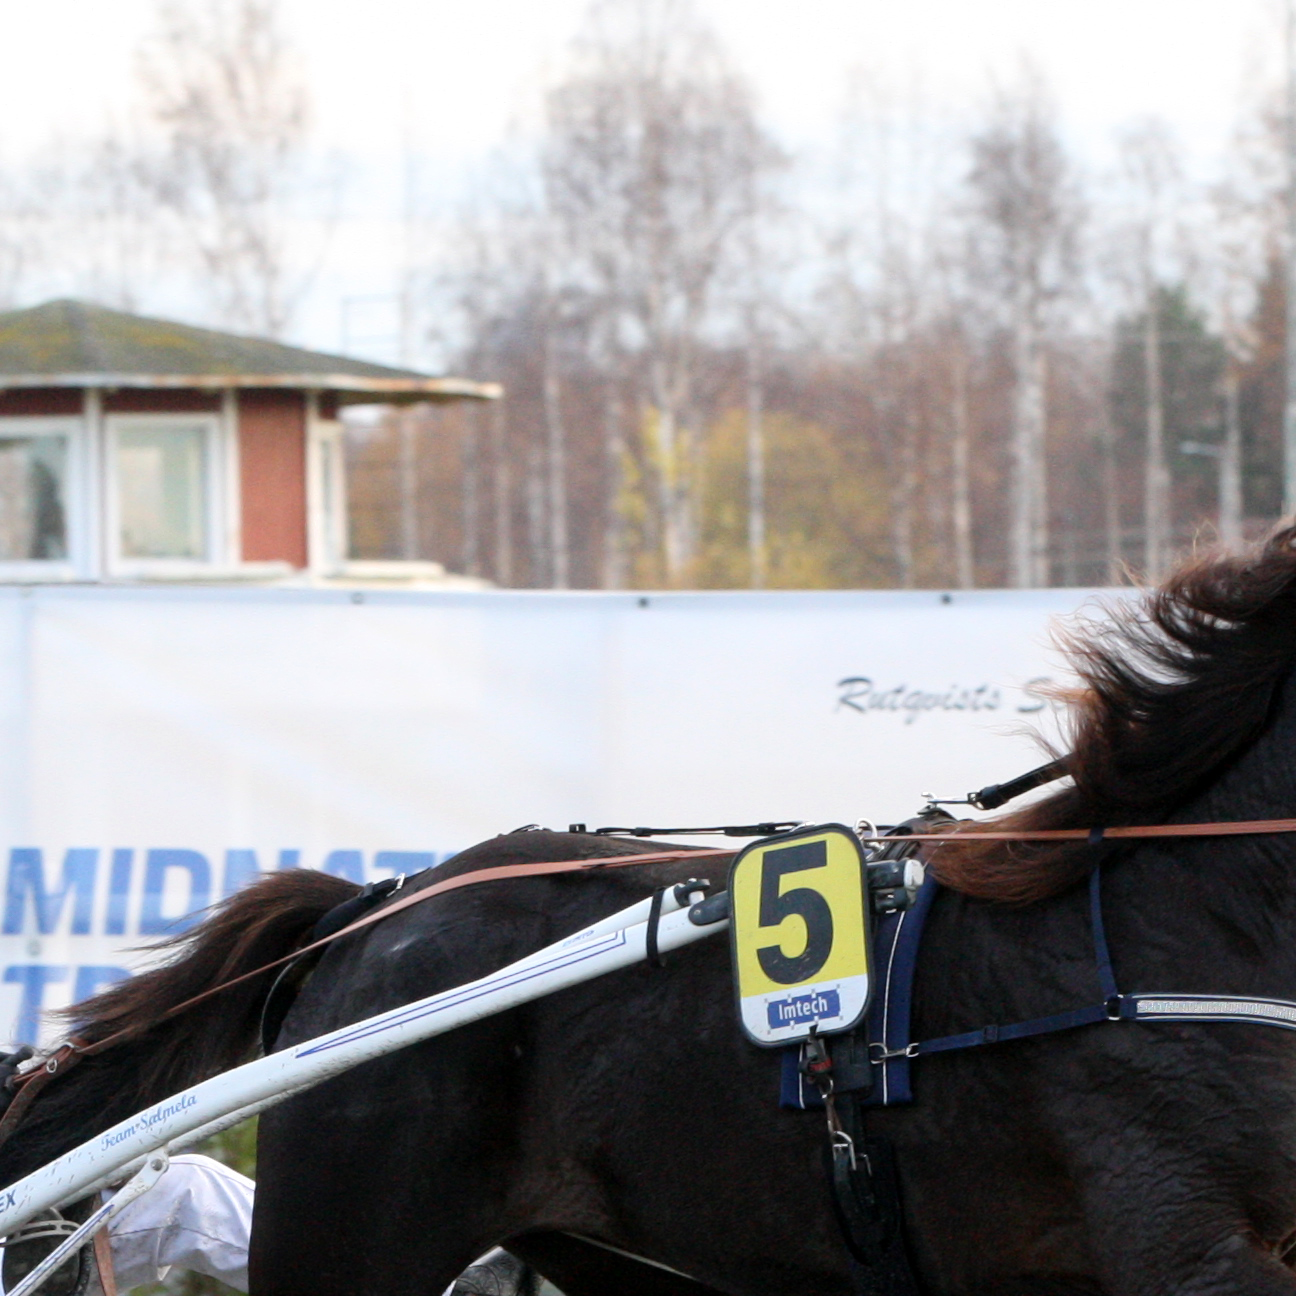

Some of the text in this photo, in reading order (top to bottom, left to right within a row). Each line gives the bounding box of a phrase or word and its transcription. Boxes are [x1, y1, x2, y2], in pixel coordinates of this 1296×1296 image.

[757, 840, 833, 985] 5
[779, 997, 828, 1020] Imtech
[101, 1095, 197, 1151] Team Salmela
